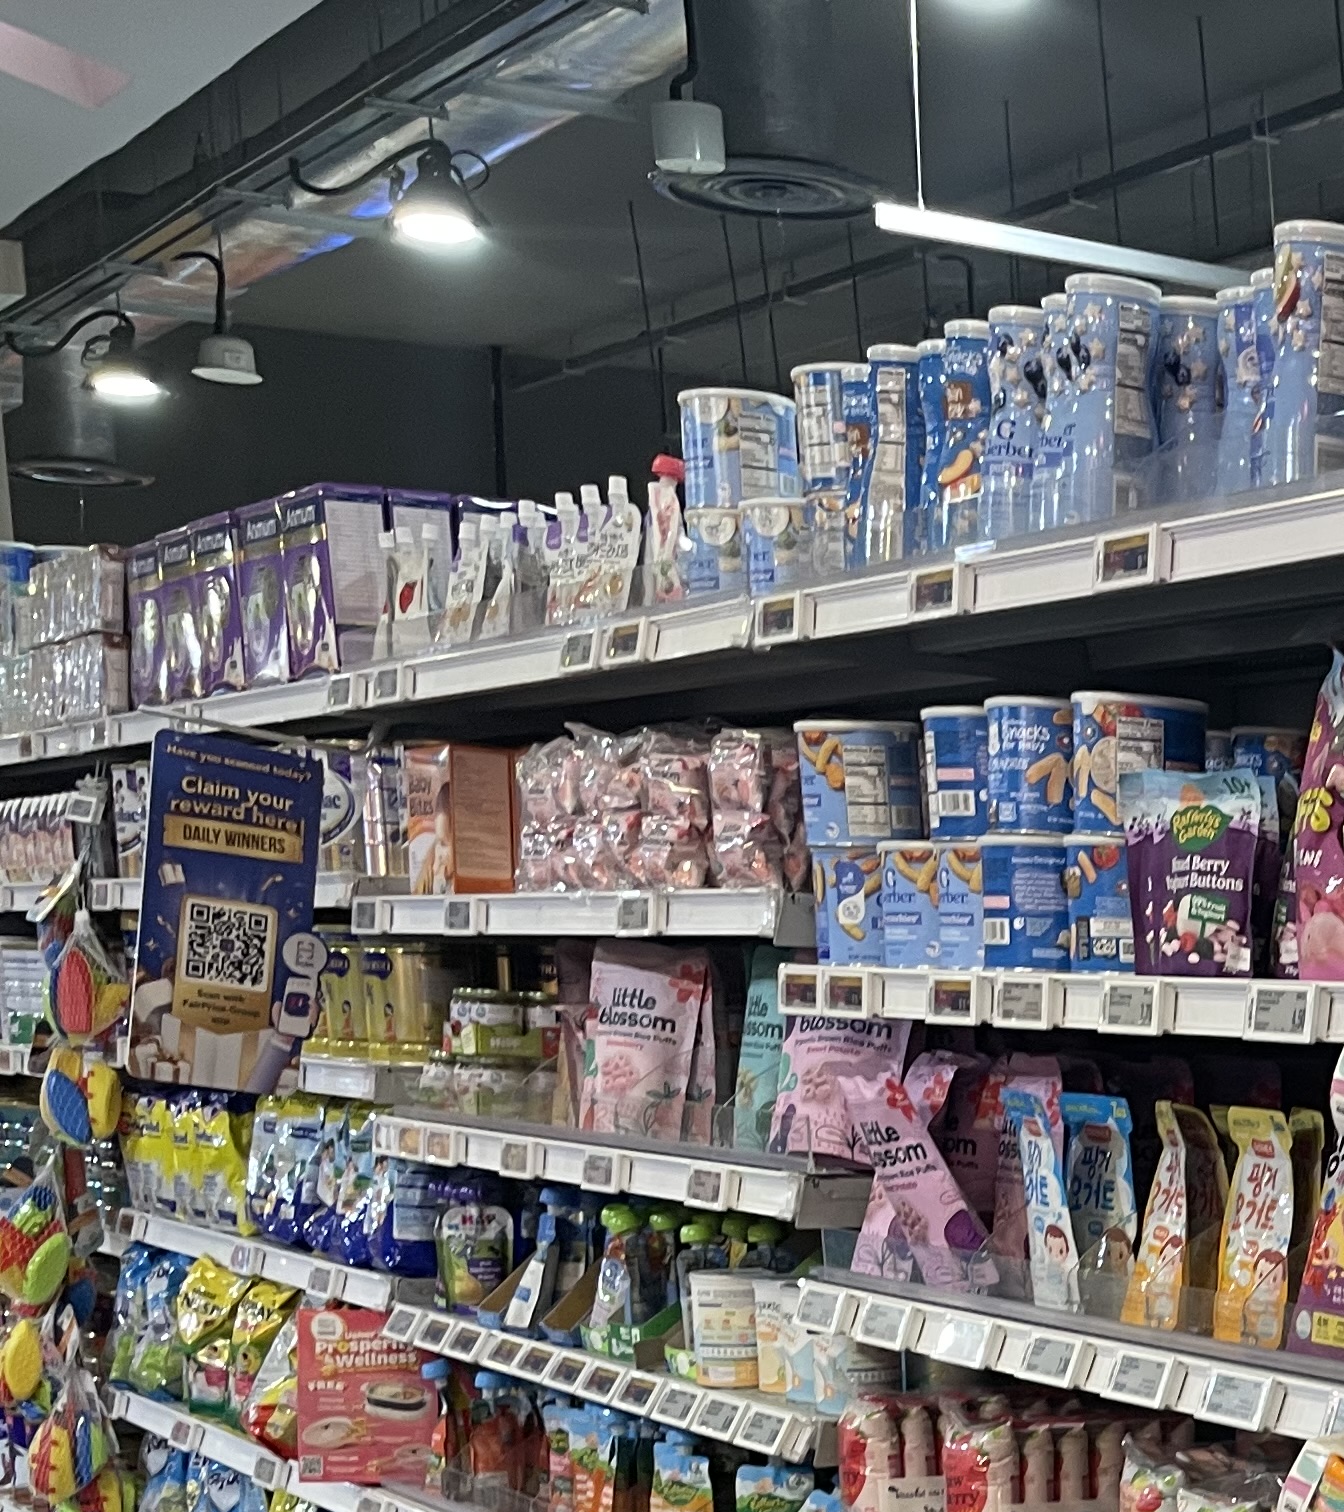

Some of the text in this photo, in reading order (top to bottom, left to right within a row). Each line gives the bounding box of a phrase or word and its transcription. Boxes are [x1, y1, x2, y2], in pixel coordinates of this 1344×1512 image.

[180, 775, 295, 814] Claim your
[170, 797, 246, 822] reward
[182, 823, 287, 855] DAILY WINNERS
[1191, 854, 1230, 876] Berry
[1189, 872, 1244, 893] Buttons
[611, 987, 657, 1011] little
[600, 1006, 677, 1034] blossom
[796, 1015, 892, 1040] blossom
[335, 1352, 417, 1368] Wellness
